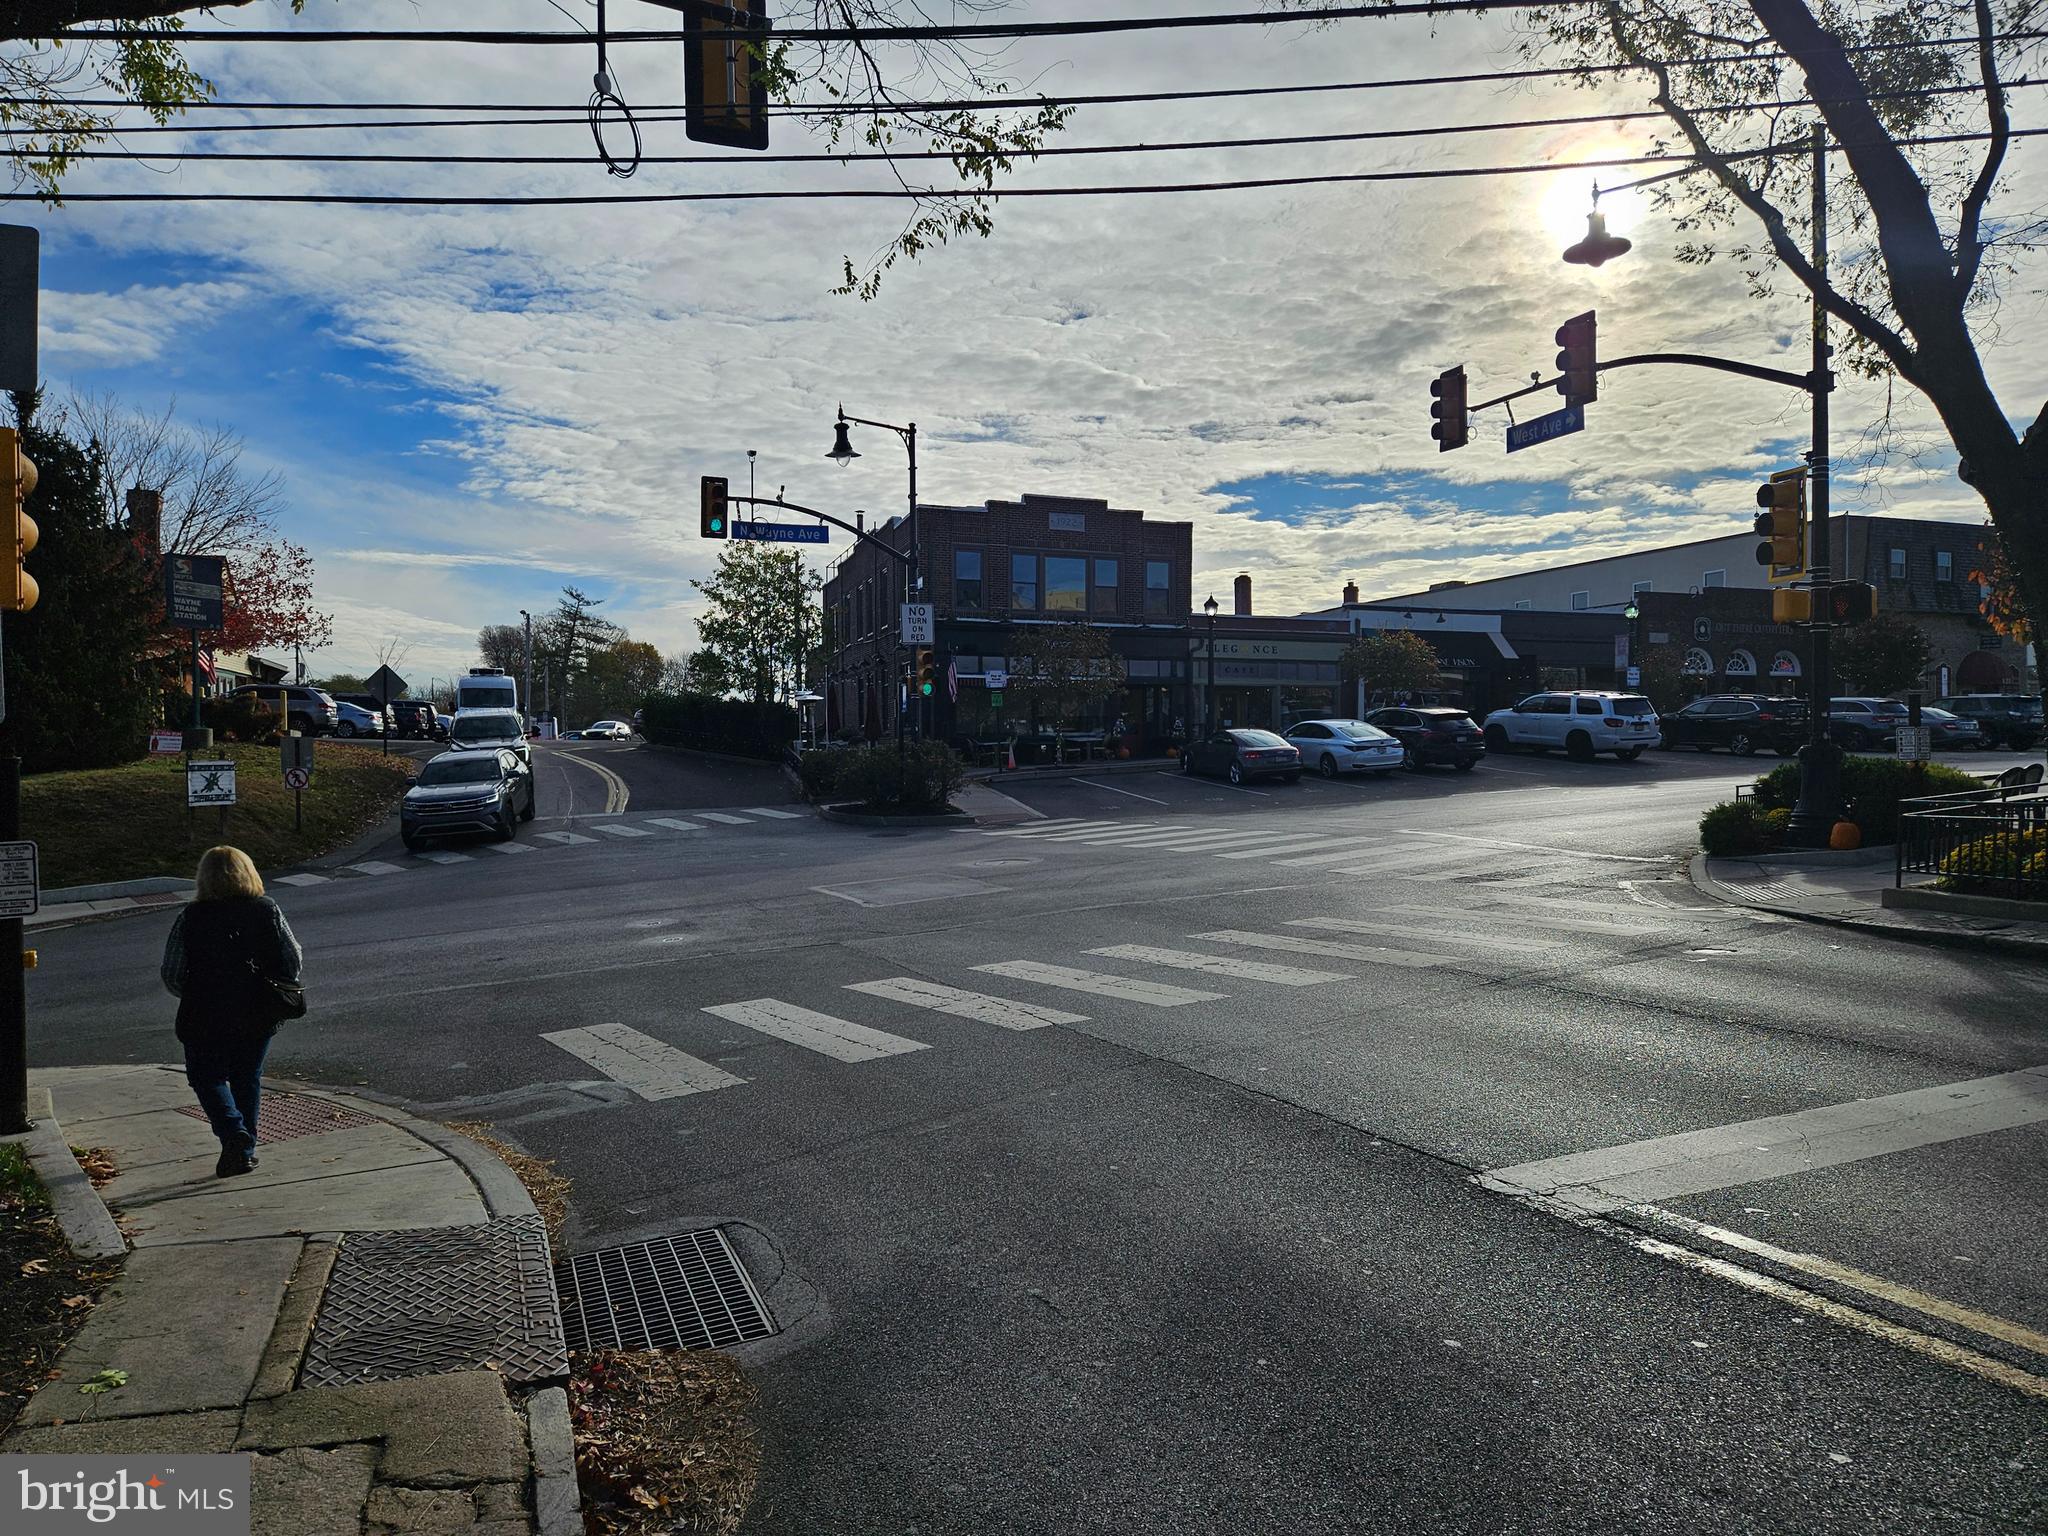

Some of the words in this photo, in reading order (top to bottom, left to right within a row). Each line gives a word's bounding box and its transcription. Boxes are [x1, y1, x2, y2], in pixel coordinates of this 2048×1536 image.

[1513, 425, 1538, 445] West
[1541, 419, 1562, 436] Ave
[755, 526, 794, 540] Wayne
[798, 529, 821, 540] Ave
[174, 597, 202, 606] WAYNE
[174, 604, 198, 613] TRAIN
[909, 607, 926, 616] NO
[174, 612, 207, 621] STATION
[912, 625, 923, 633] ON
[911, 633, 926, 641] RED
